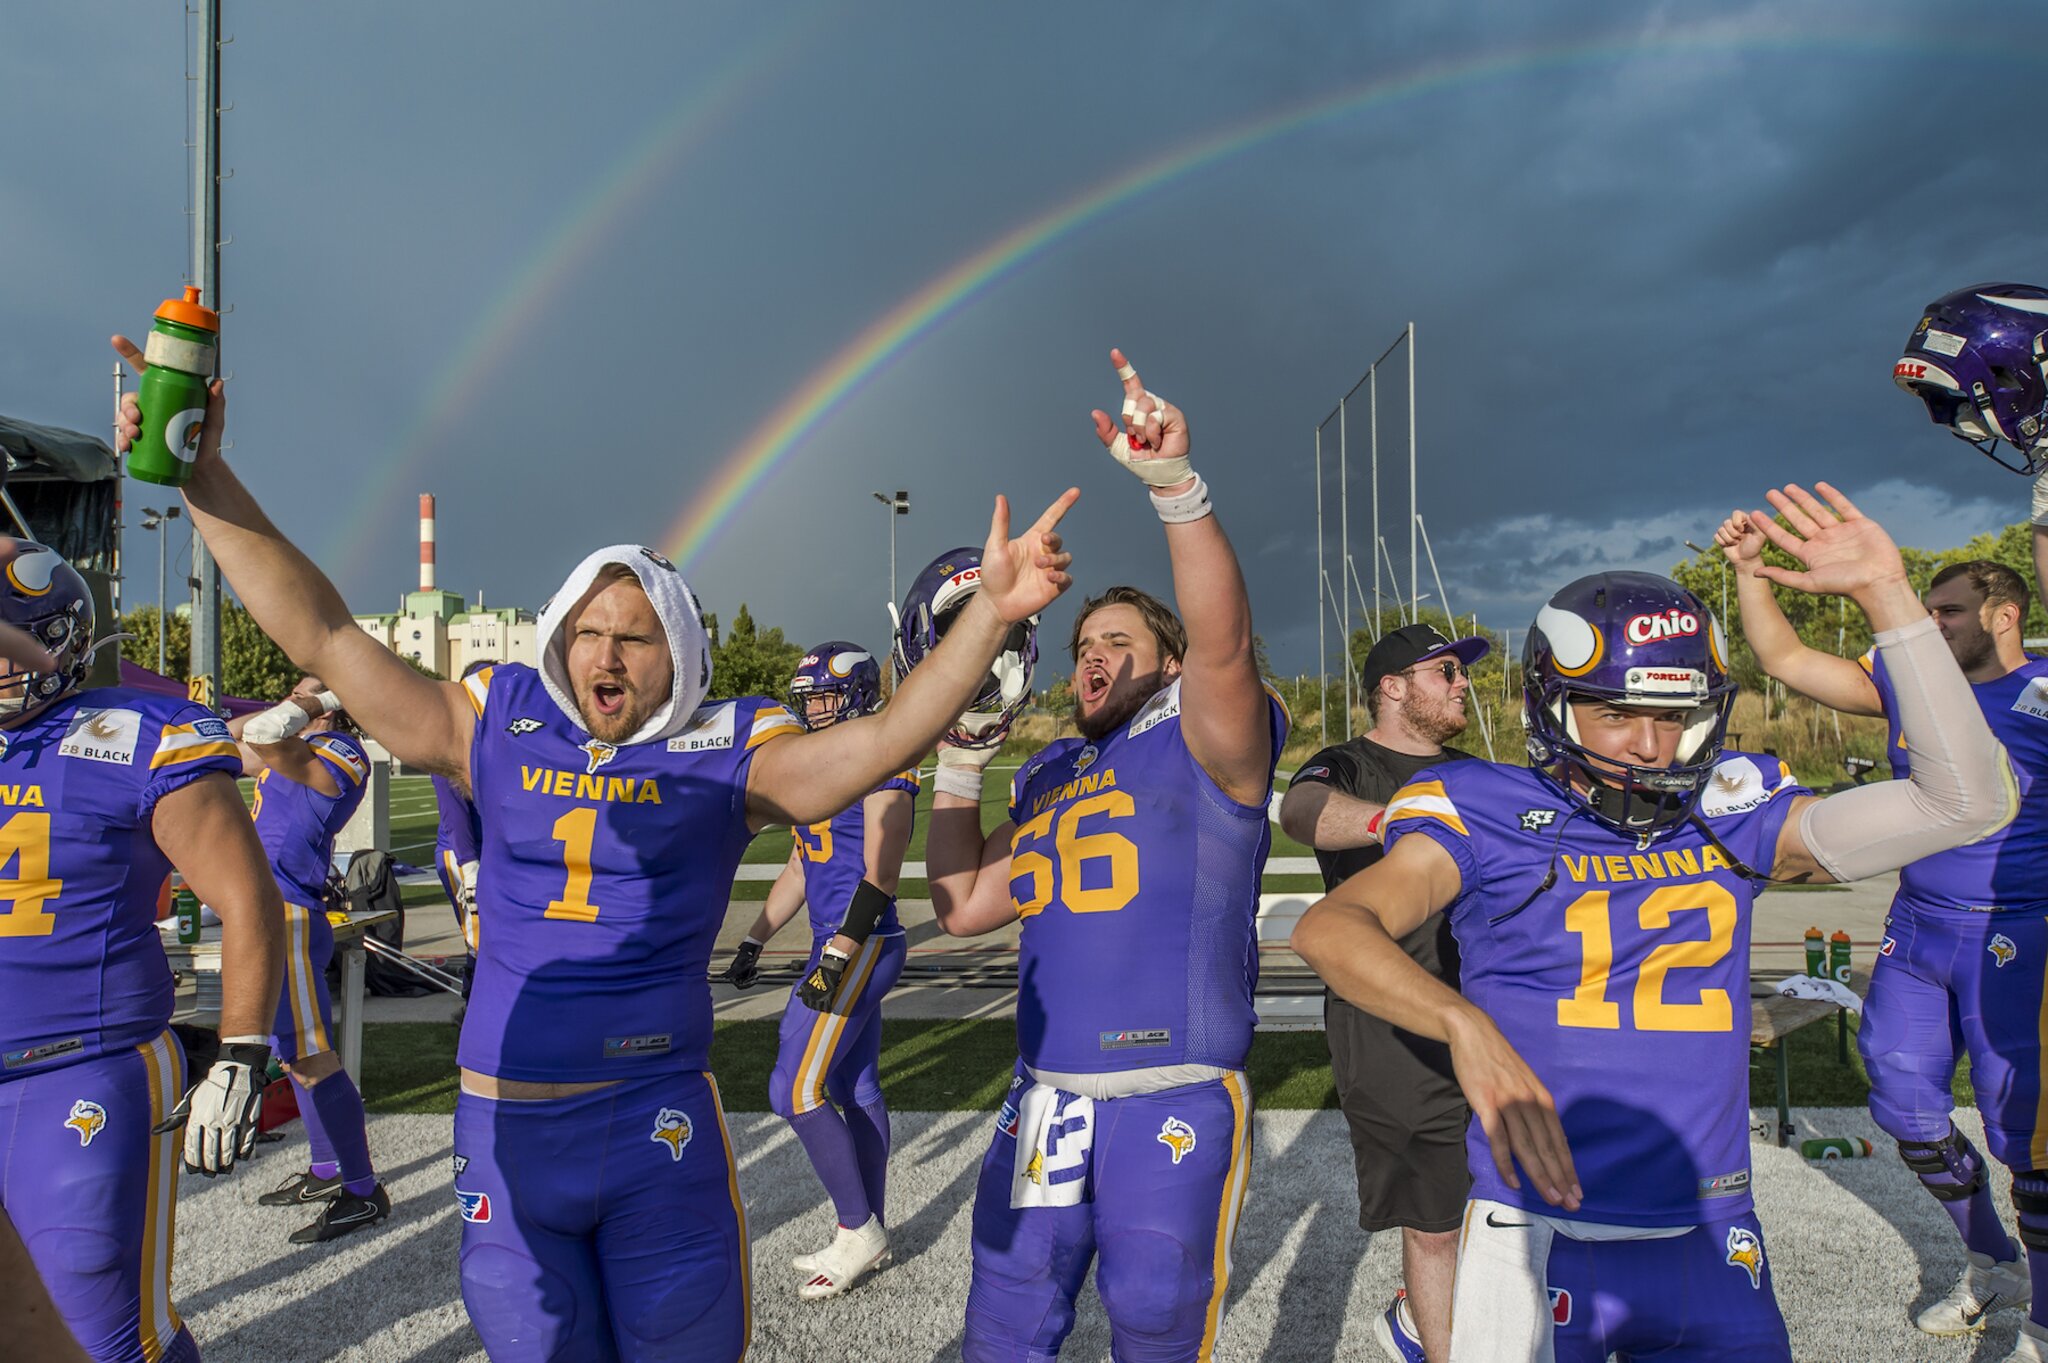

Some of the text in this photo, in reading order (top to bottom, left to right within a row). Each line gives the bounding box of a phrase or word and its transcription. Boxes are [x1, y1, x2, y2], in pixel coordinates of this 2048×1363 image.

[1625, 609, 1699, 645] Chio
[1646, 672, 1691, 681] FORELLE
[1145, 703, 1178, 729] BLACK
[61, 744, 131, 763] 28 BLACK
[669, 735, 732, 750] 28 BLACK
[521, 765, 663, 805] VIENNA
[1032, 768, 1117, 815] VIENNA
[543, 806, 600, 923] 1
[1561, 844, 1732, 882] VIENNA
[1557, 879, 1738, 1032] 12
